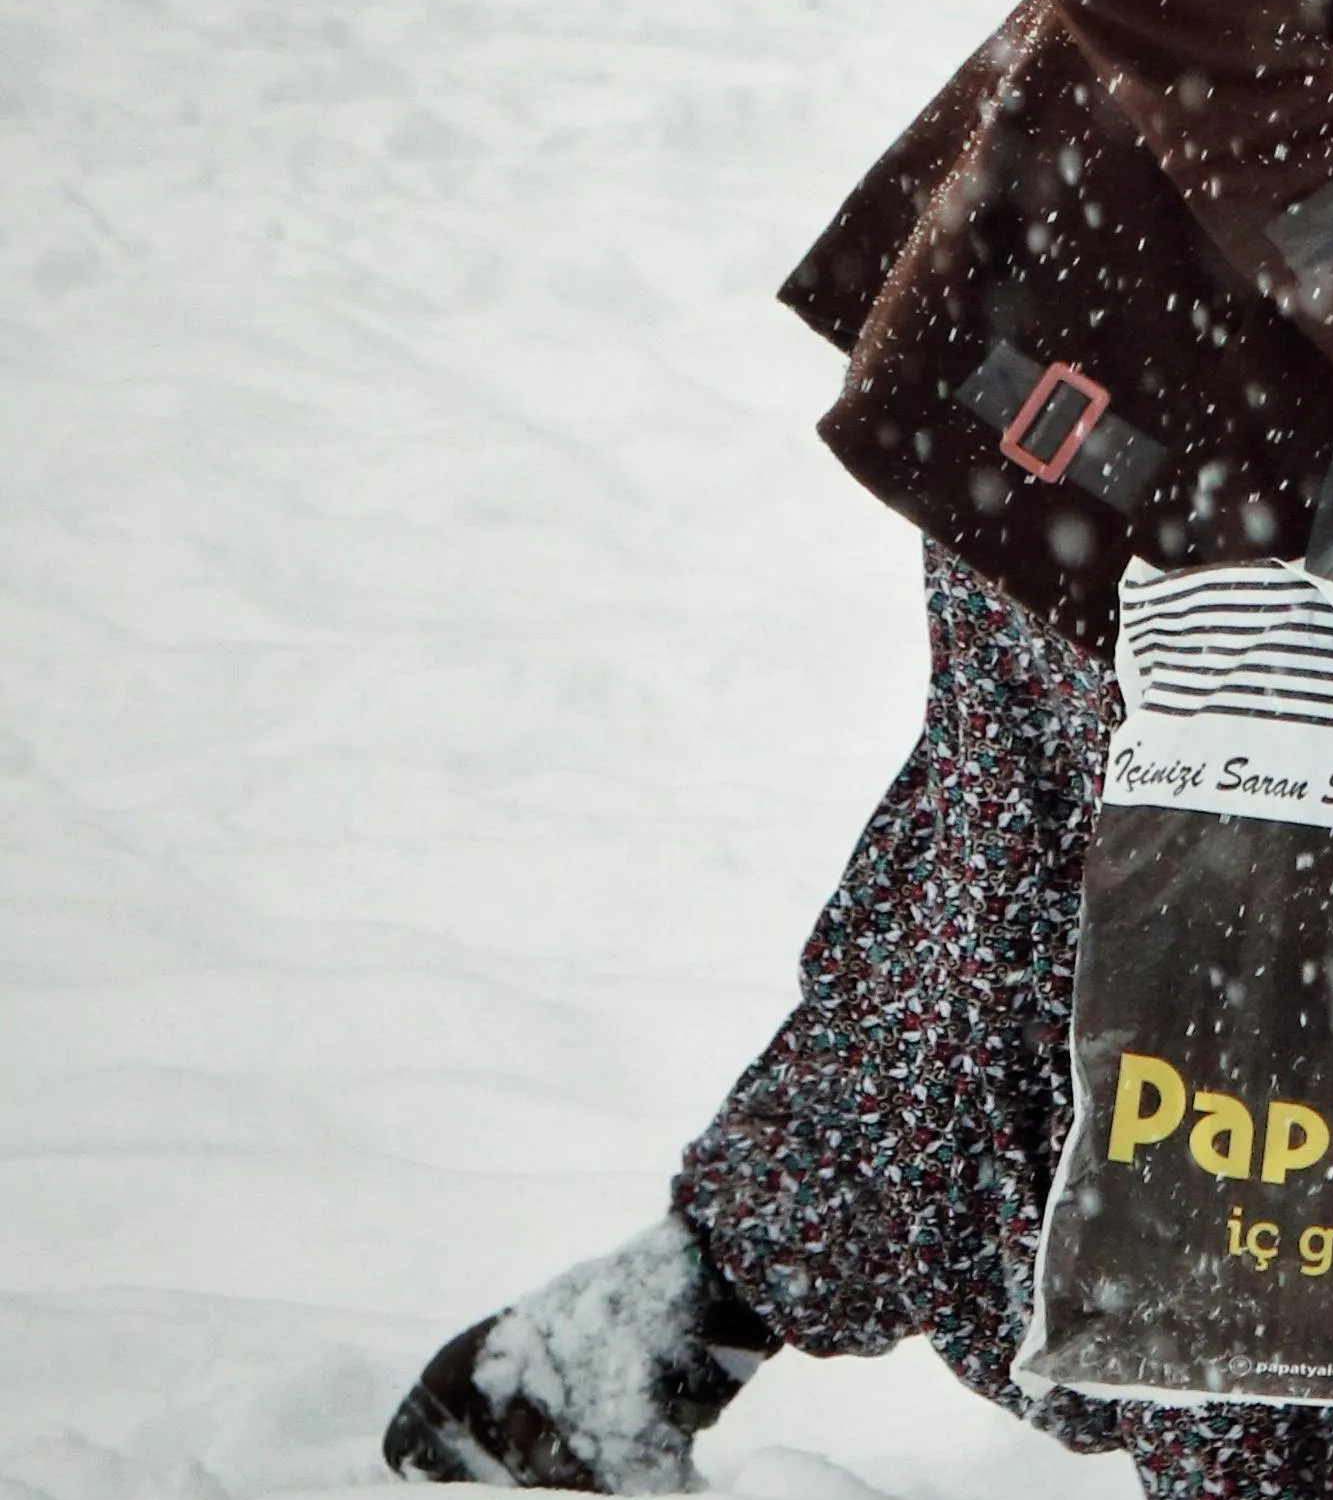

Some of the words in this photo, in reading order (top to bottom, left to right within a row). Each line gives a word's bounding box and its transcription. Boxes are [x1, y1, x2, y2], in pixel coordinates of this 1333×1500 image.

[1114, 740, 1207, 797] İçinizi
[1216, 756, 1309, 800] Saran
[1225, 1206, 1280, 1269] iç
